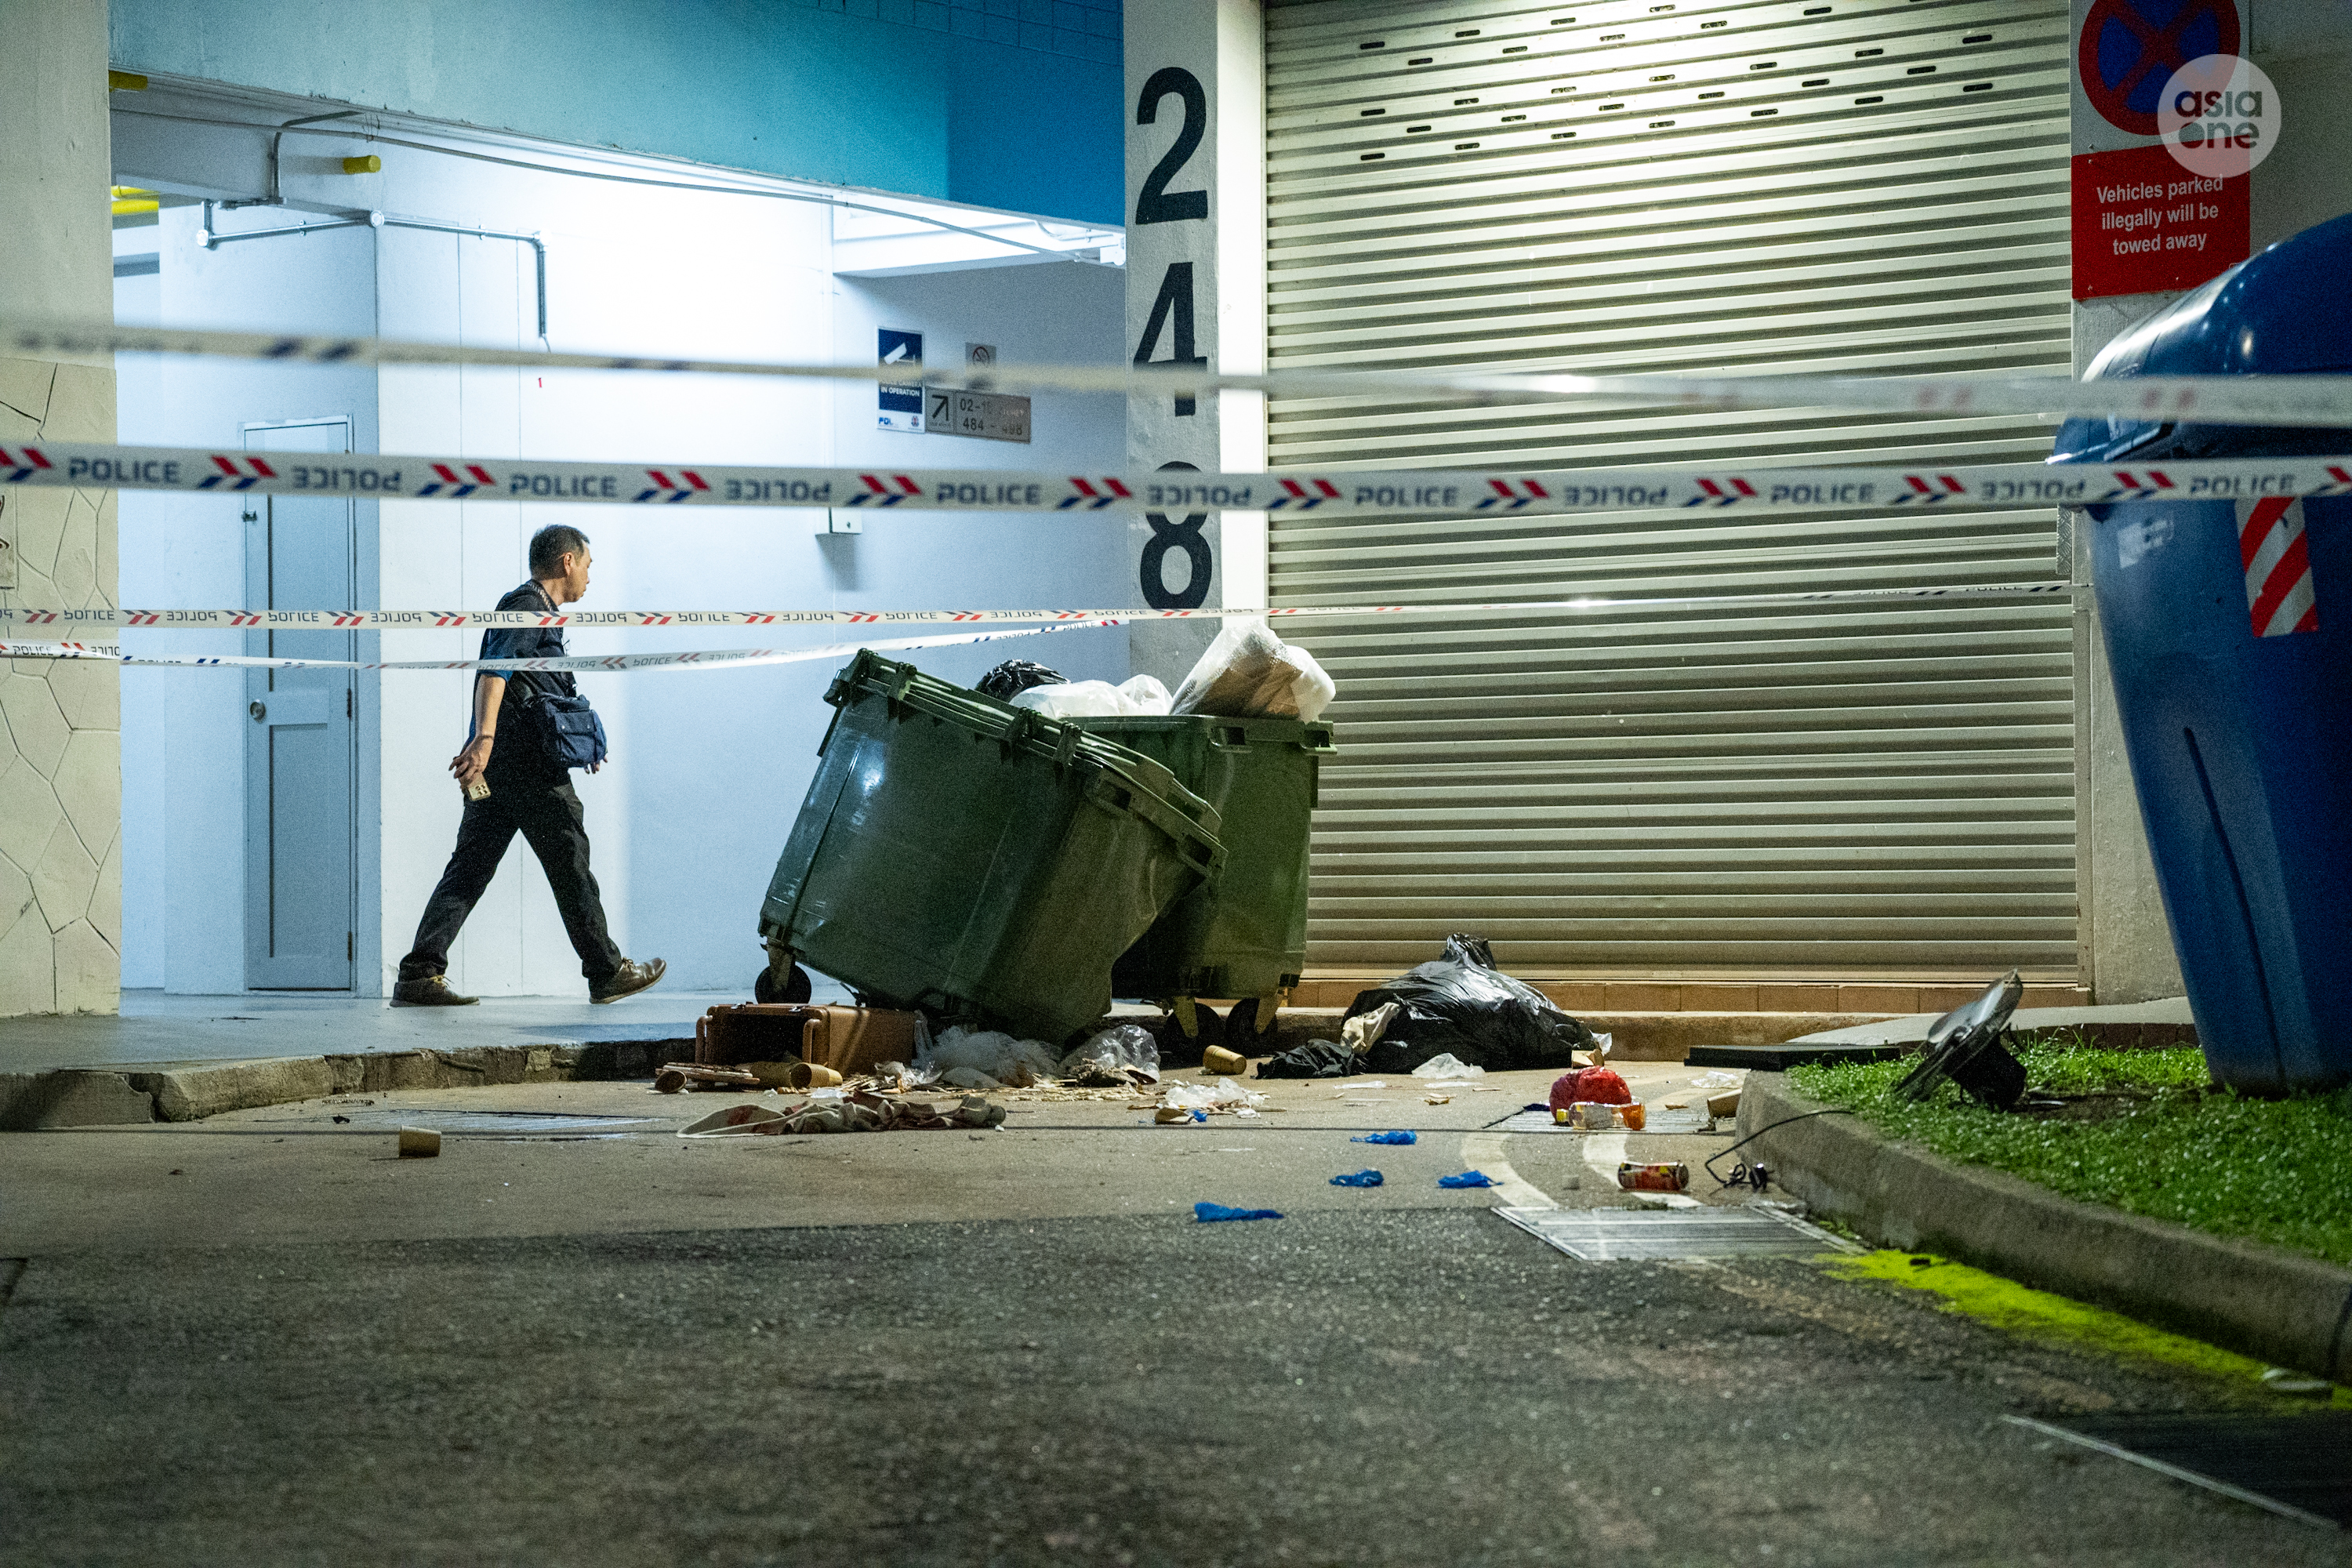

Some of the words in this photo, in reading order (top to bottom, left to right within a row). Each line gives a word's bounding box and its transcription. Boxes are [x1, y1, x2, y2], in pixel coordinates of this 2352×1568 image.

[2096, 182, 2163, 204] Vehicles
[2168, 173, 2223, 200] parked
[2102, 208, 2161, 232] illegally
[2166, 202, 2194, 223] will
[2198, 201, 2220, 220] be
[2113, 234, 2161, 255] towed
[2165, 233, 2208, 252] away
[888, 387, 920, 397] OPERATION
[963, 417, 984, 431] 484
[69, 458, 180, 484] POLICE
[292, 466, 402, 492] POLICE
[510, 474, 617, 498] POLICE
[725, 479, 831, 502] POLICE
[937, 483, 1041, 506] POLICE
[1147, 484, 1251, 506] POLICE
[1355, 485, 1458, 506] POLICE
[1564, 485, 1668, 506] POLICE
[1771, 483, 1874, 504] POLICE
[1981, 480, 2085, 501] POLICE
[2190, 474, 2297, 495] POLICE
[13, 645, 54, 655] POLICE
